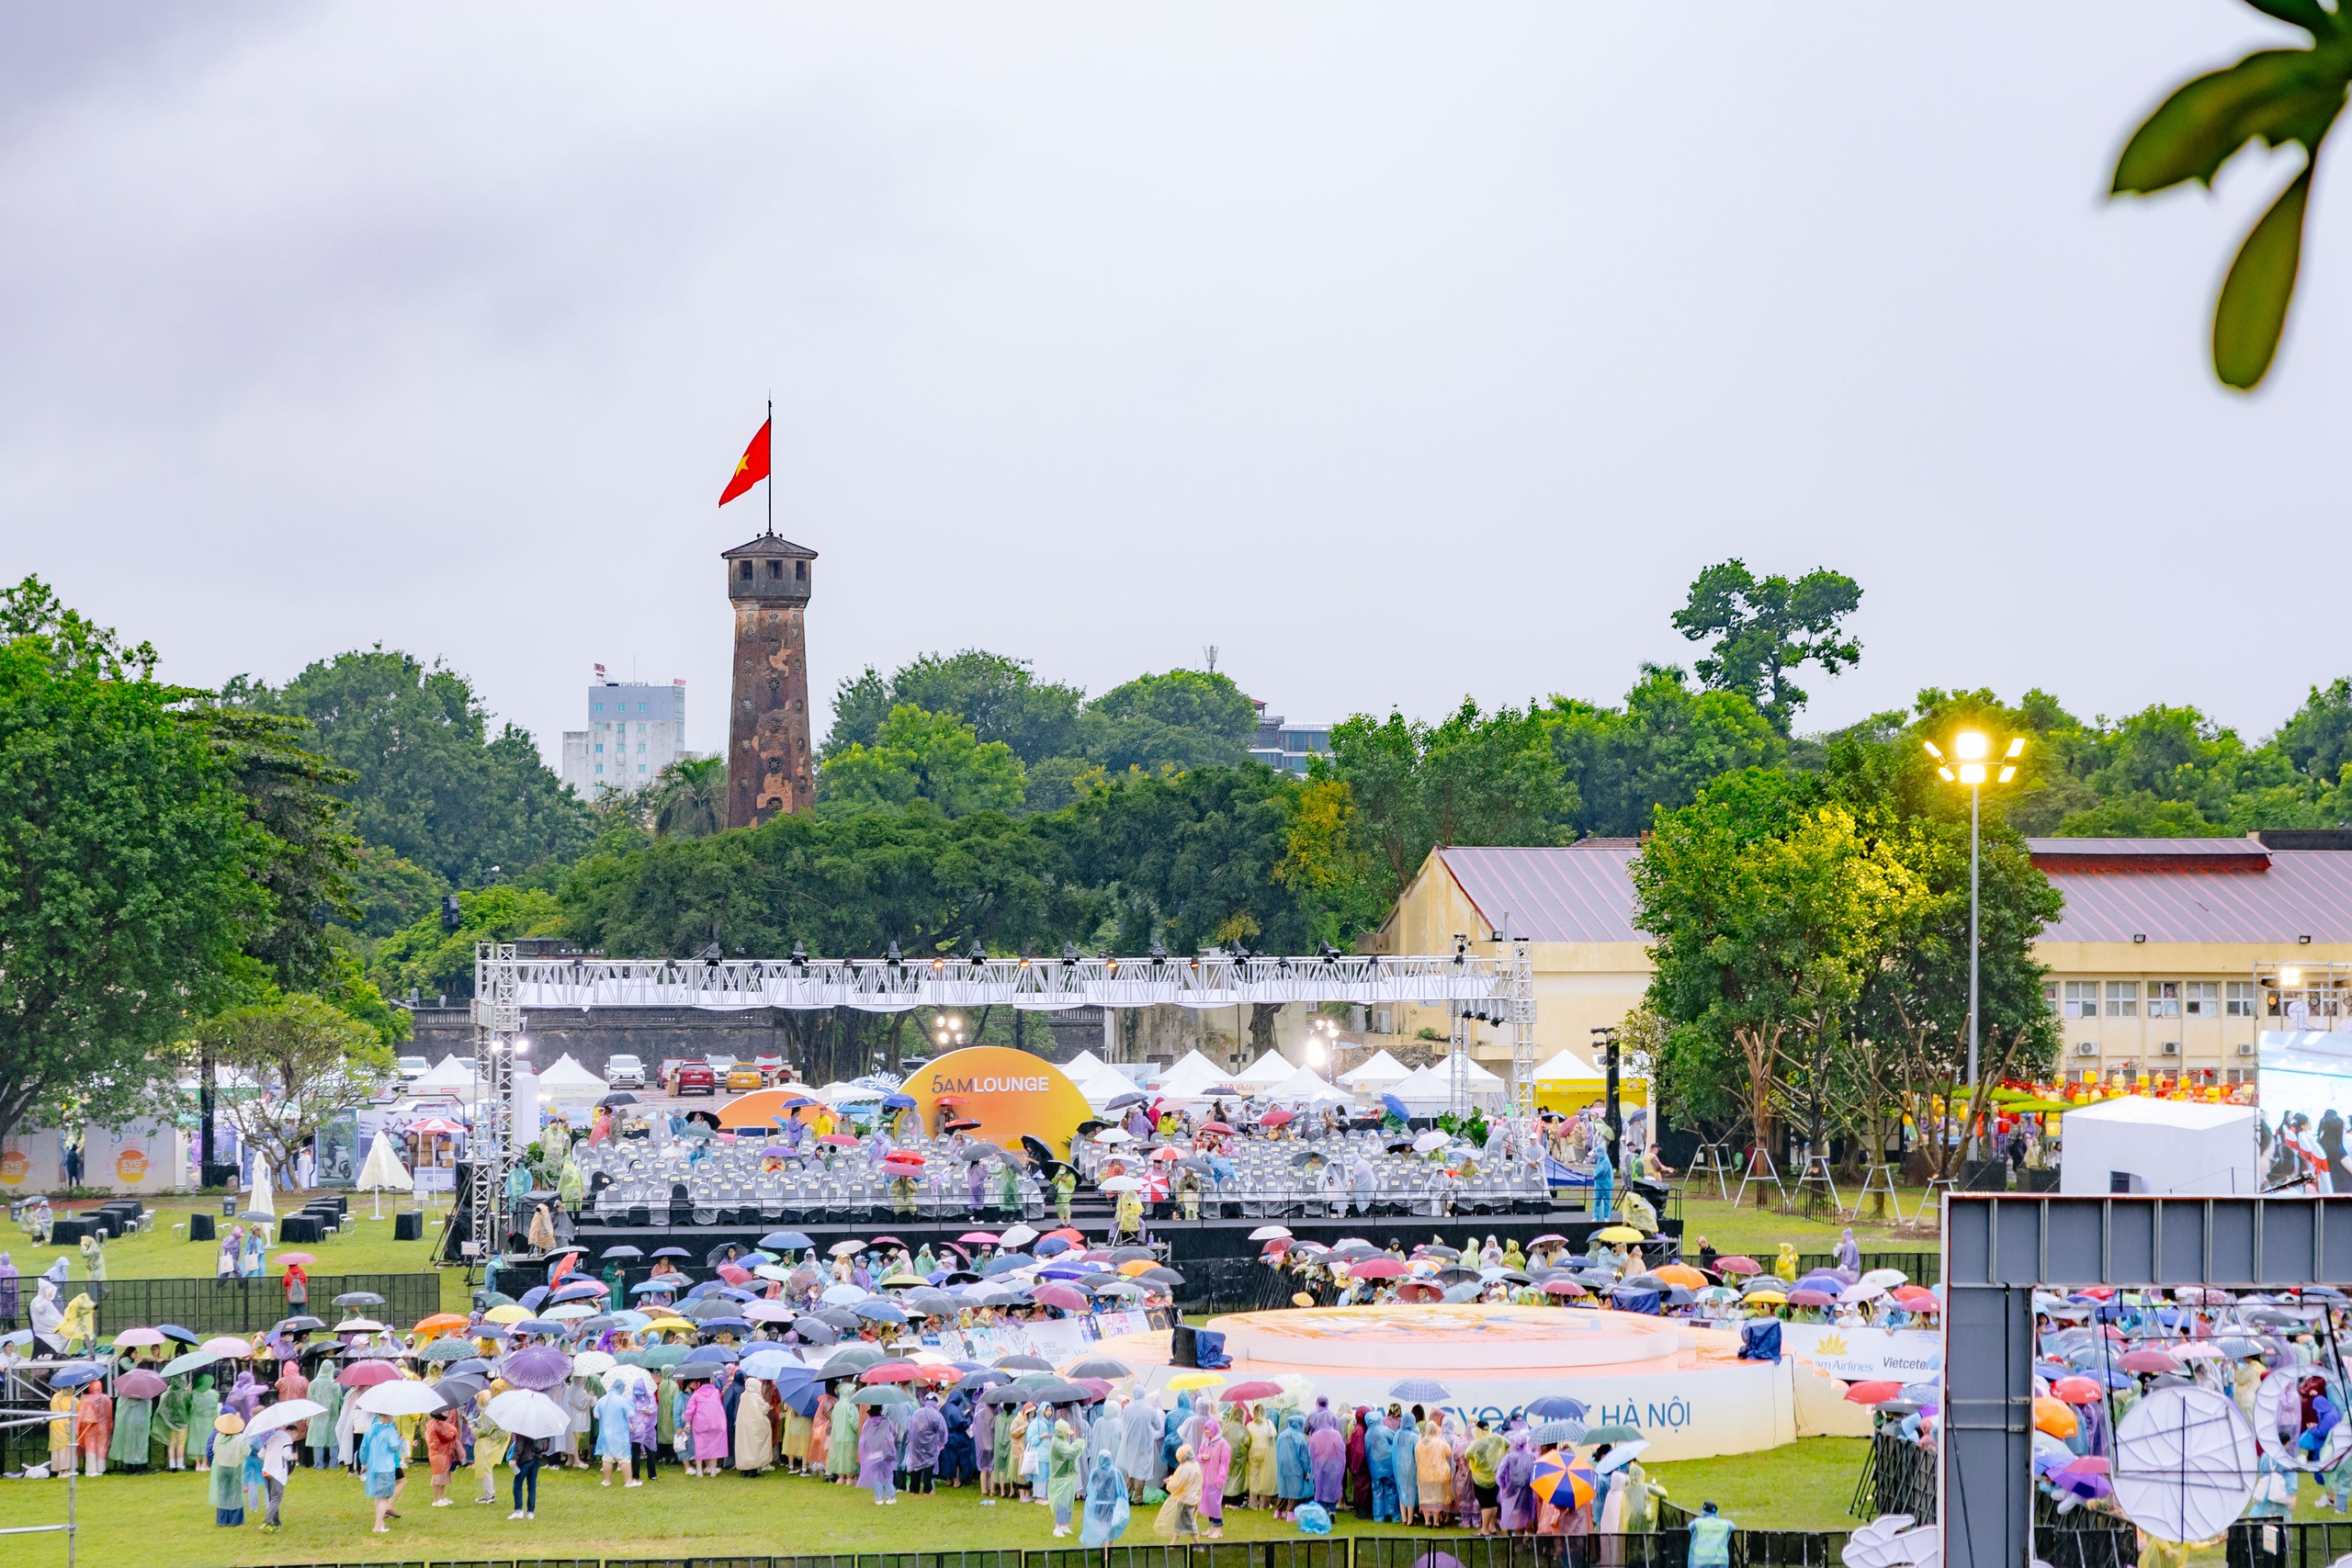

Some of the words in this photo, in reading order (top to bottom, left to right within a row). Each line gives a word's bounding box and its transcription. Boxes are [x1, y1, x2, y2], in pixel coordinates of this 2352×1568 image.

[1832, 1359, 1874, 1373] Airlines
[1883, 1357, 1939, 1371] Vietcete
[1601, 1397, 1642, 1428] HÀ
[1648, 1395, 1690, 1433] NỘI
